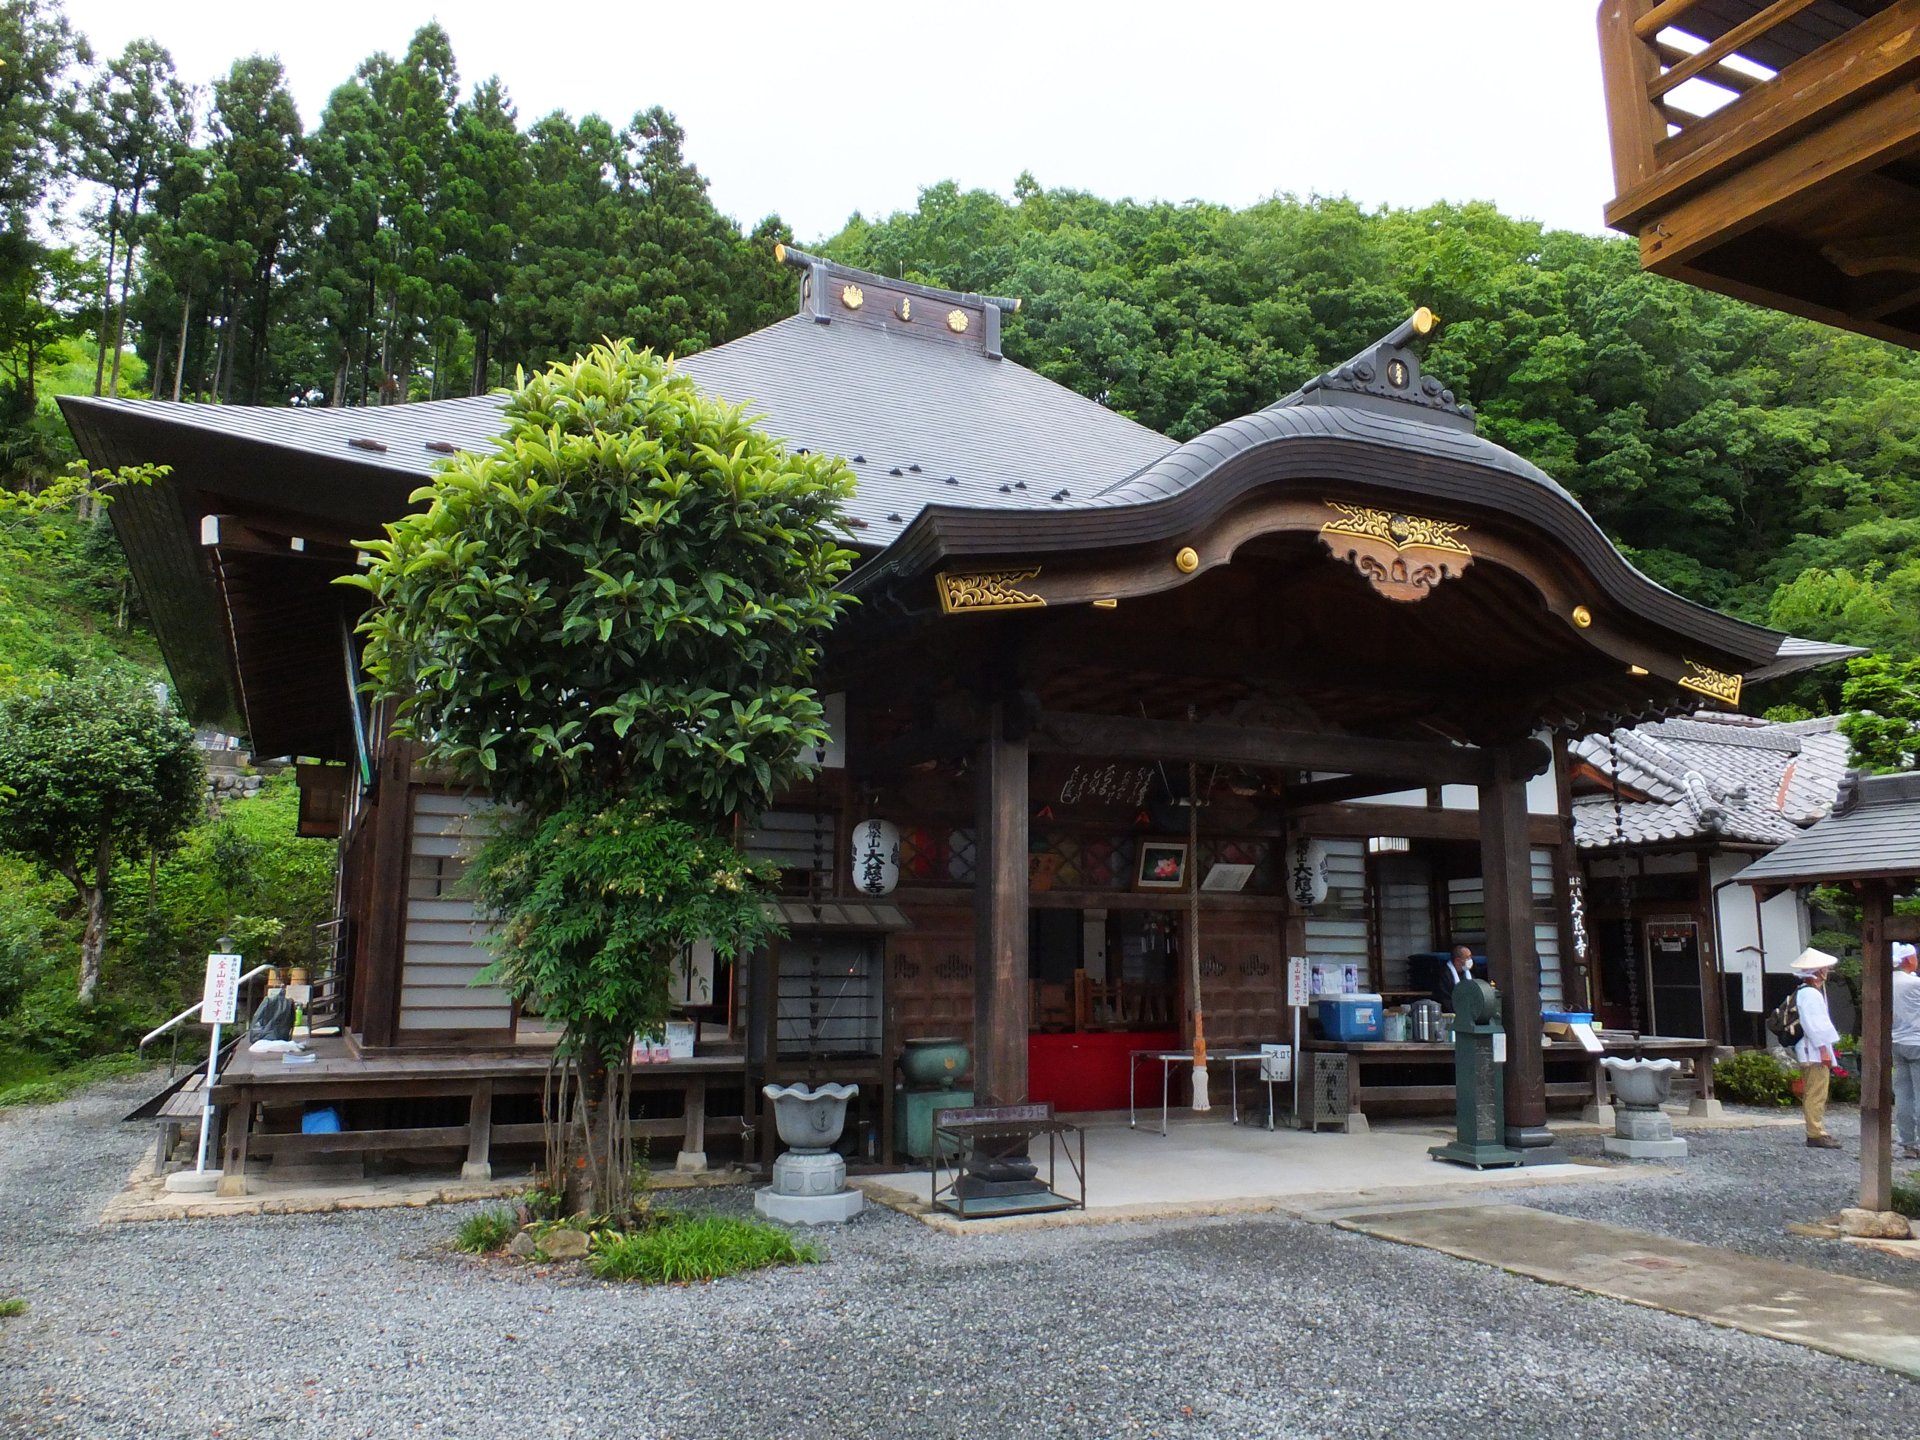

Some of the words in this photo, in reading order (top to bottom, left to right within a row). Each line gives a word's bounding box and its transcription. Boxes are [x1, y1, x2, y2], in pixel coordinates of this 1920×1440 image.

[1571, 896, 1587, 958] 大慈寺
[212, 960, 227, 1017] 全山禁止です
